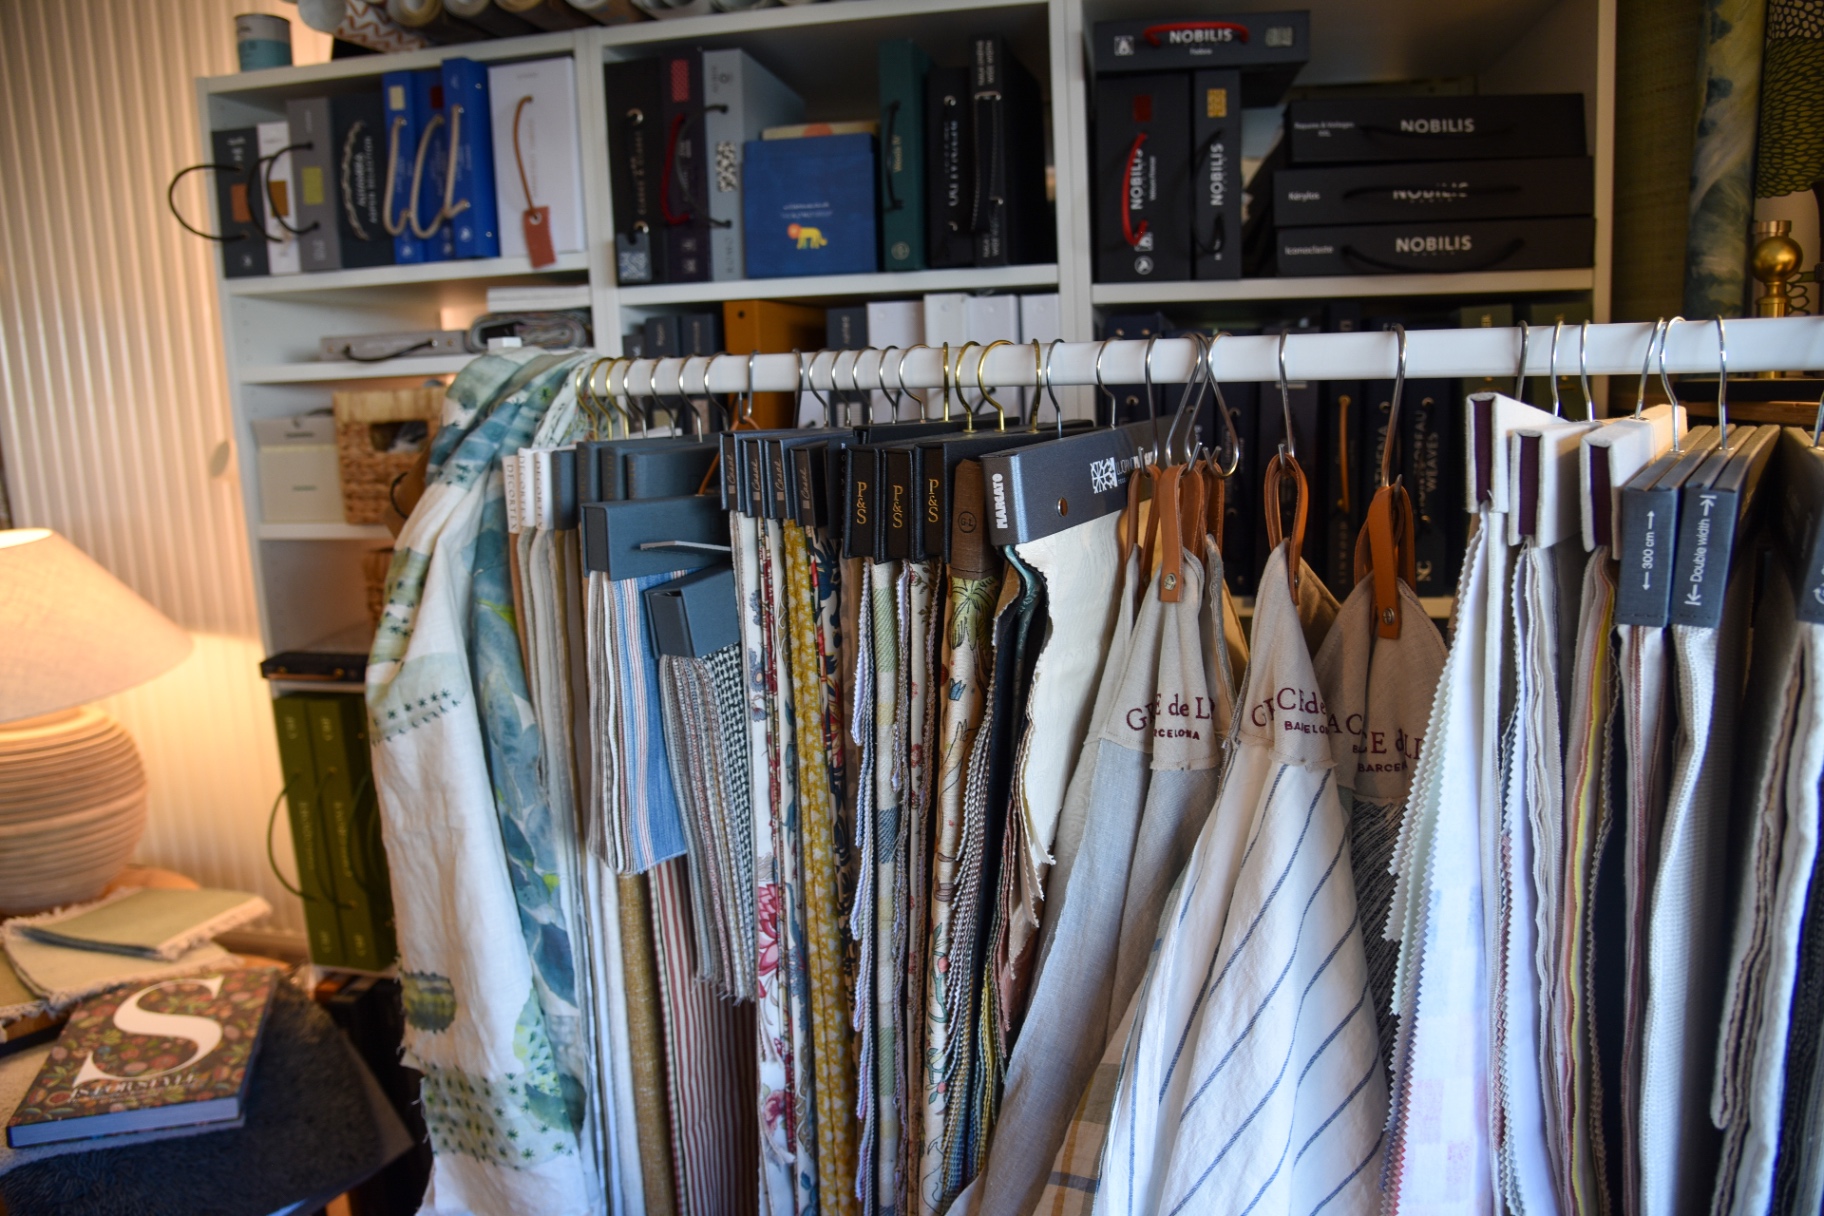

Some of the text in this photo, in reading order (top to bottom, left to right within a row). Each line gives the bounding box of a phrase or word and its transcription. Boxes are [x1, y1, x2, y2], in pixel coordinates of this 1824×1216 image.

[1169, 28, 1233, 44] NOBILIS
[1400, 118, 1475, 133] NOBILIS
[1209, 143, 1224, 206] NOBILIS
[1396, 235, 1472, 253] NOBILIS
[727, 451, 736, 485] Casal
[752, 459, 761, 491] Casal
[774, 459, 784, 491] Casal
[1426, 432, 1439, 492] WEAVES
[506, 464, 518, 529] DECORTEX
[800, 467, 810, 500] Casal
[1642, 531, 1655, 569] 300 cm
[1690, 517, 1711, 583] Double width
[1168, 692, 1190, 717] de
[72, 974, 225, 1089] S
